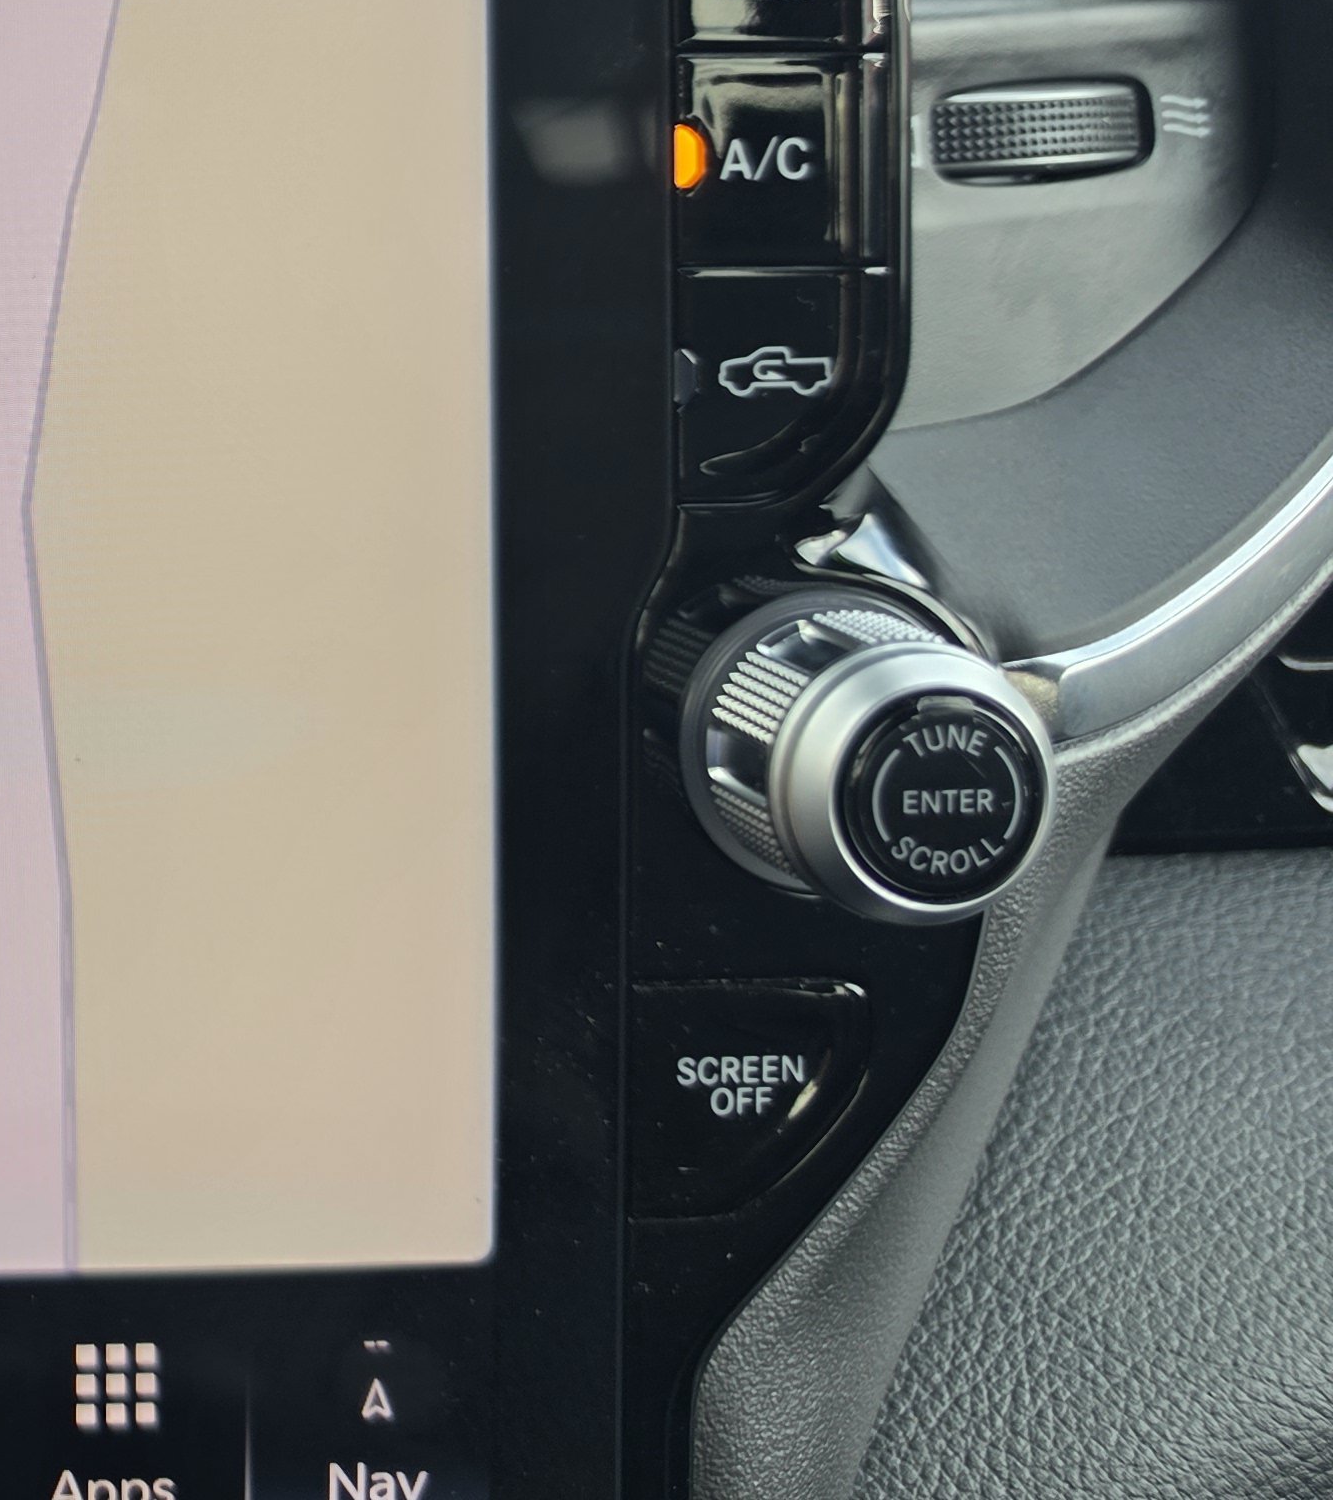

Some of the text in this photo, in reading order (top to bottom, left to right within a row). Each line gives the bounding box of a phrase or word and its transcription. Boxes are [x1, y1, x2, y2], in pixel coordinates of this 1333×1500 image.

[719, 137, 811, 182] A/C
[903, 724, 988, 758] TUNE
[902, 788, 994, 815] ENTER
[891, 835, 1004, 876] SCROLL
[676, 1054, 806, 1087] SCREEN
[709, 1085, 773, 1116] OFF
[328, 1461, 430, 1500] Nav
